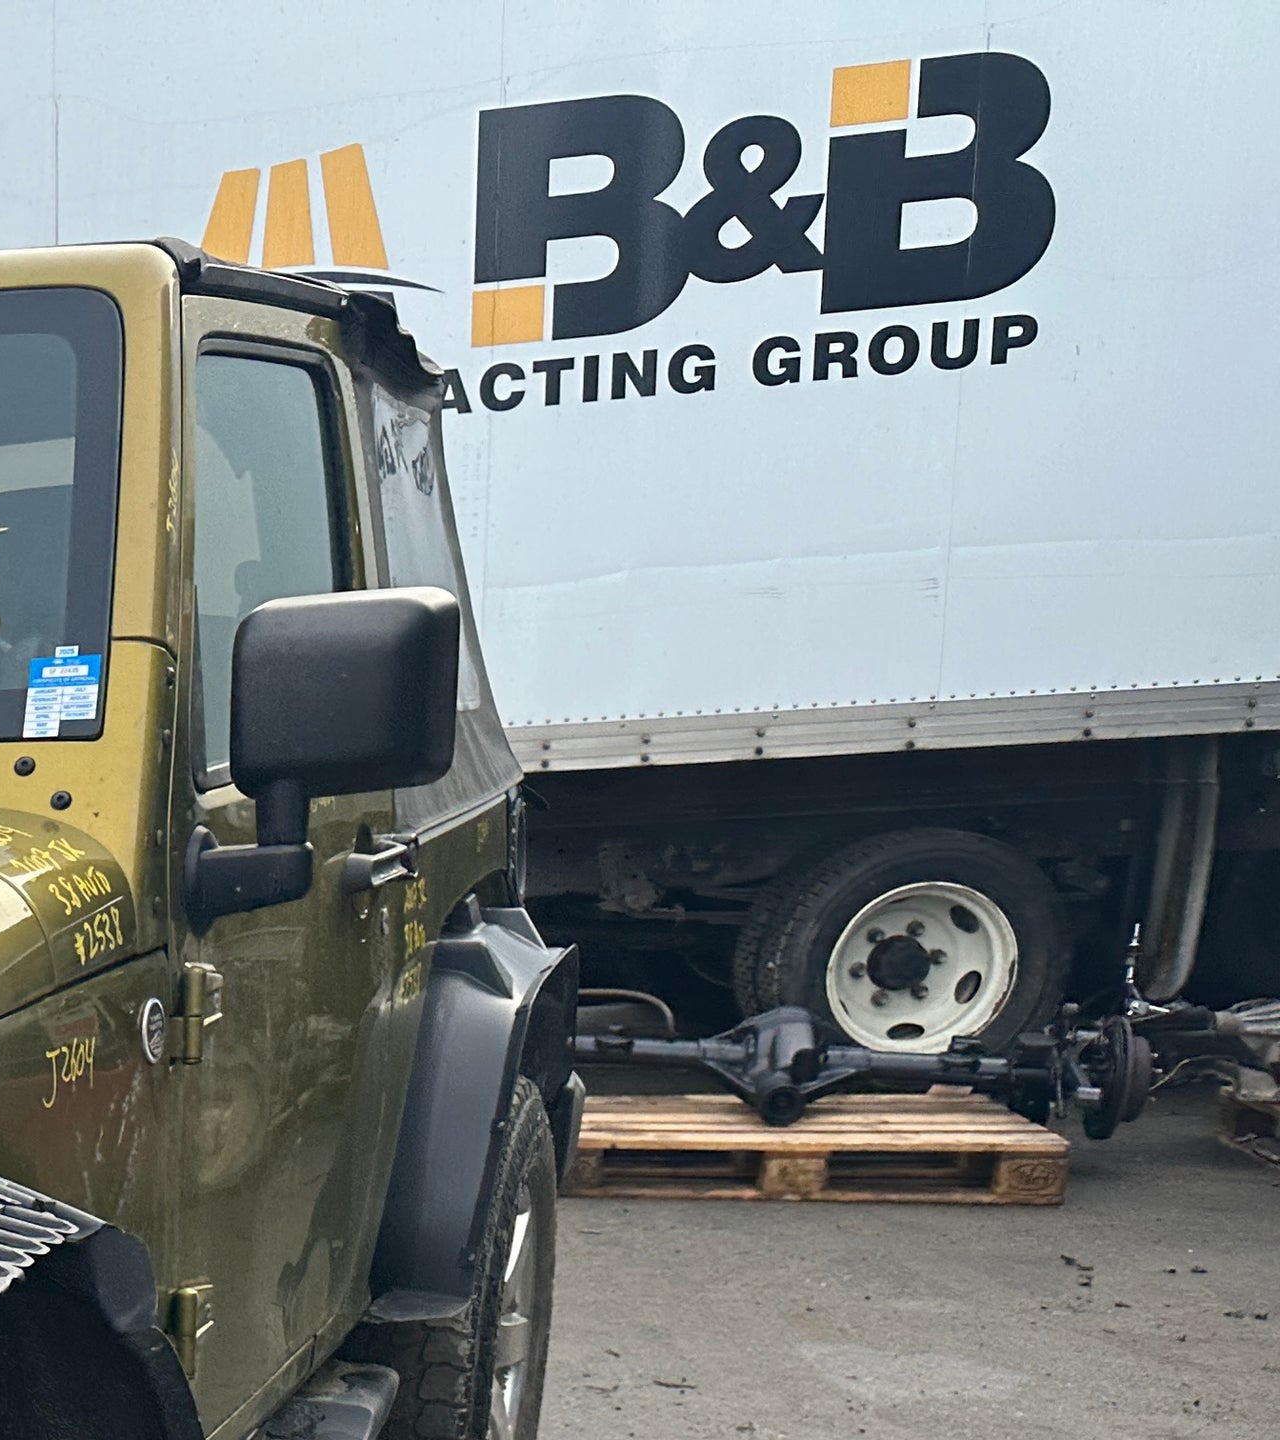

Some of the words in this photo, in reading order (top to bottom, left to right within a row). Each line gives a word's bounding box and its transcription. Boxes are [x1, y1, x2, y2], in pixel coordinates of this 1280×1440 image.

[471, 51, 1056, 347] B&B
[751, 314, 1039, 387] GROUP
[41, 1035, 97, 1109] J2604
